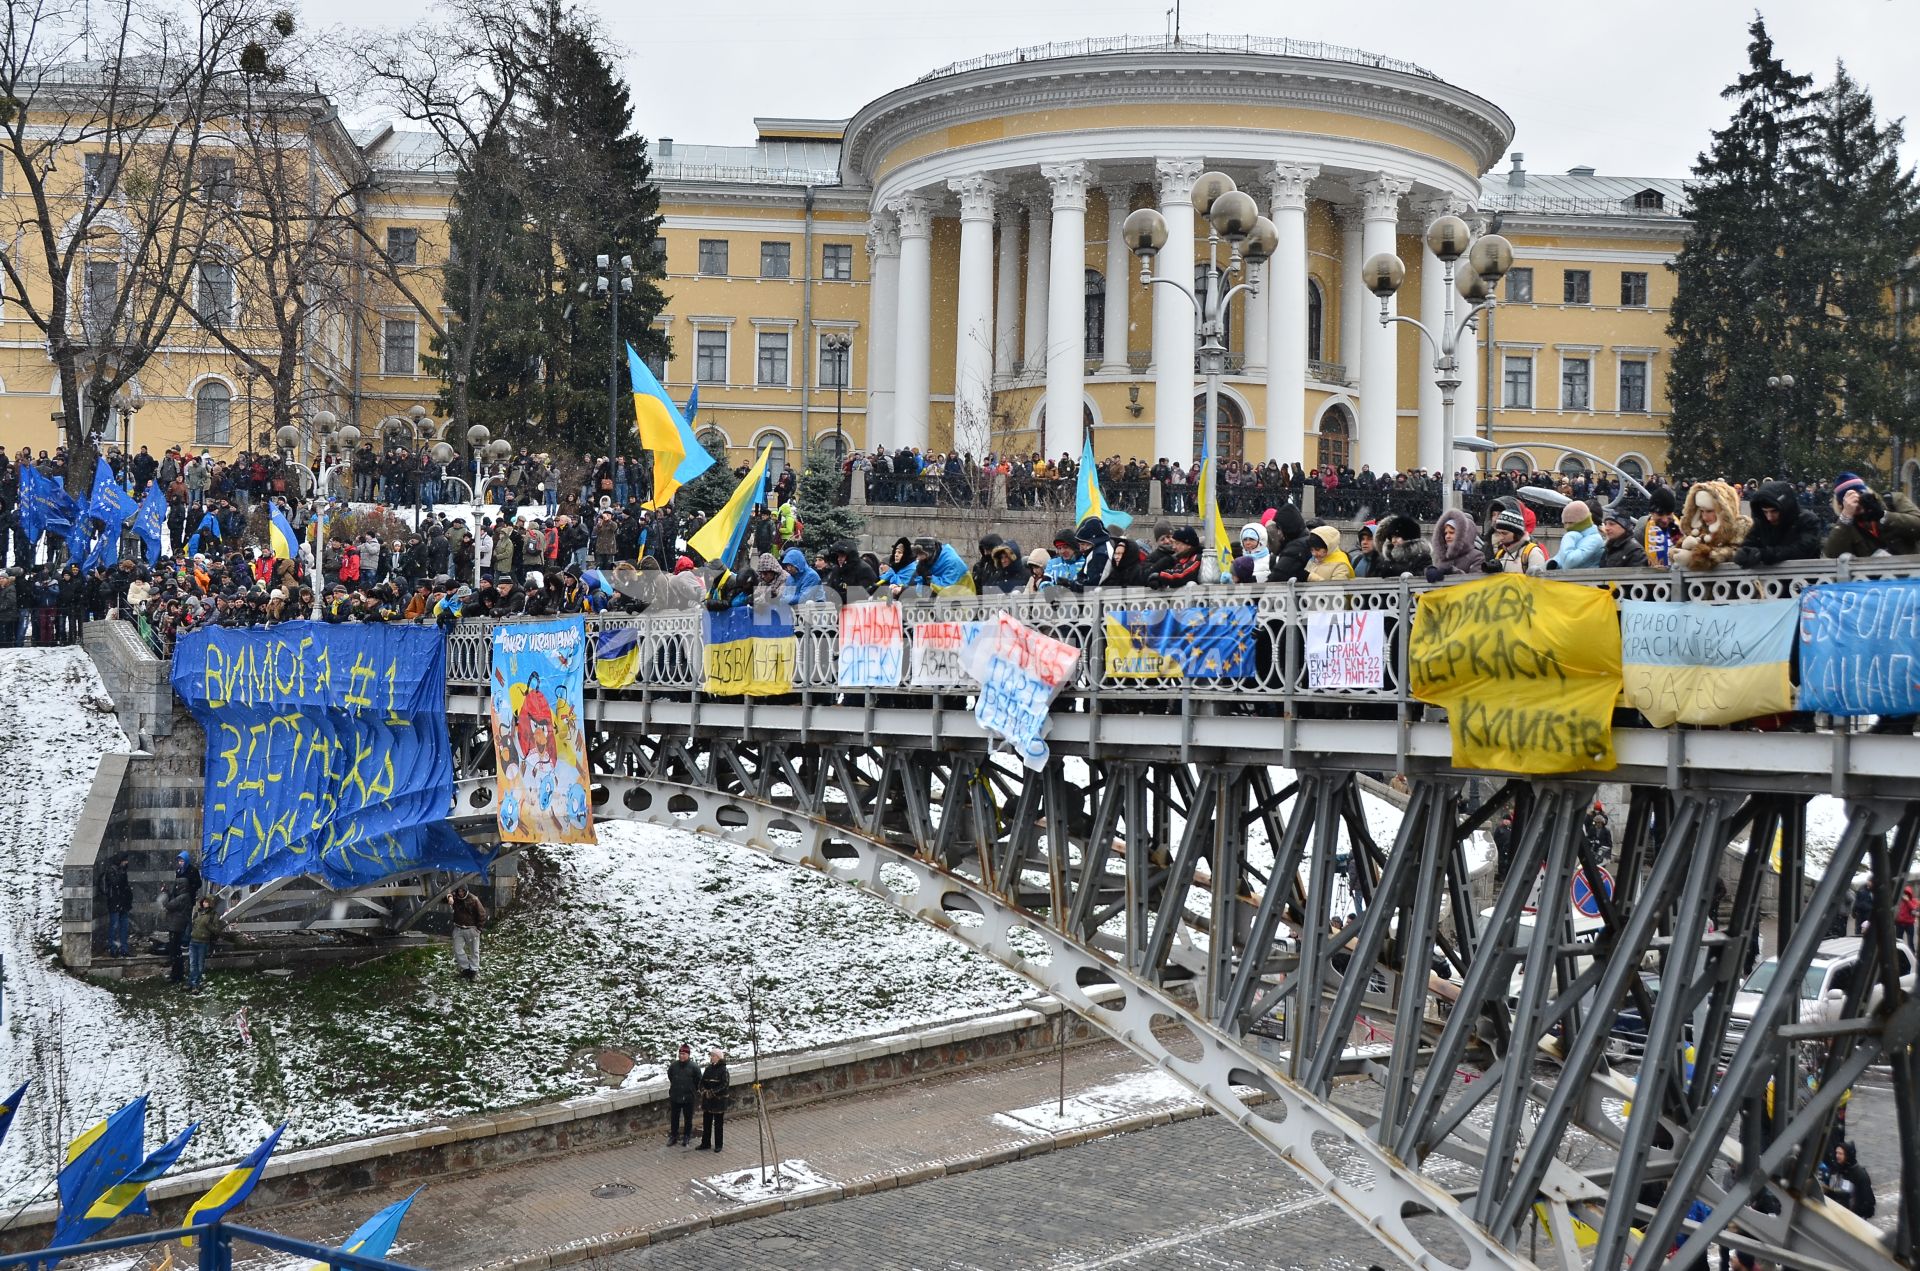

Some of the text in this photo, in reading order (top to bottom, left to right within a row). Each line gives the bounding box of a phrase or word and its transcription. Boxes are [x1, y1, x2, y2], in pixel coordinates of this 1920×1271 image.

[839, 603, 902, 646] ГАНЬБА
[916, 623, 962, 648] ГАНЬБА
[1325, 611, 1368, 643] ЛНУ
[1624, 612, 1737, 639] КРИВОТУЛИ
